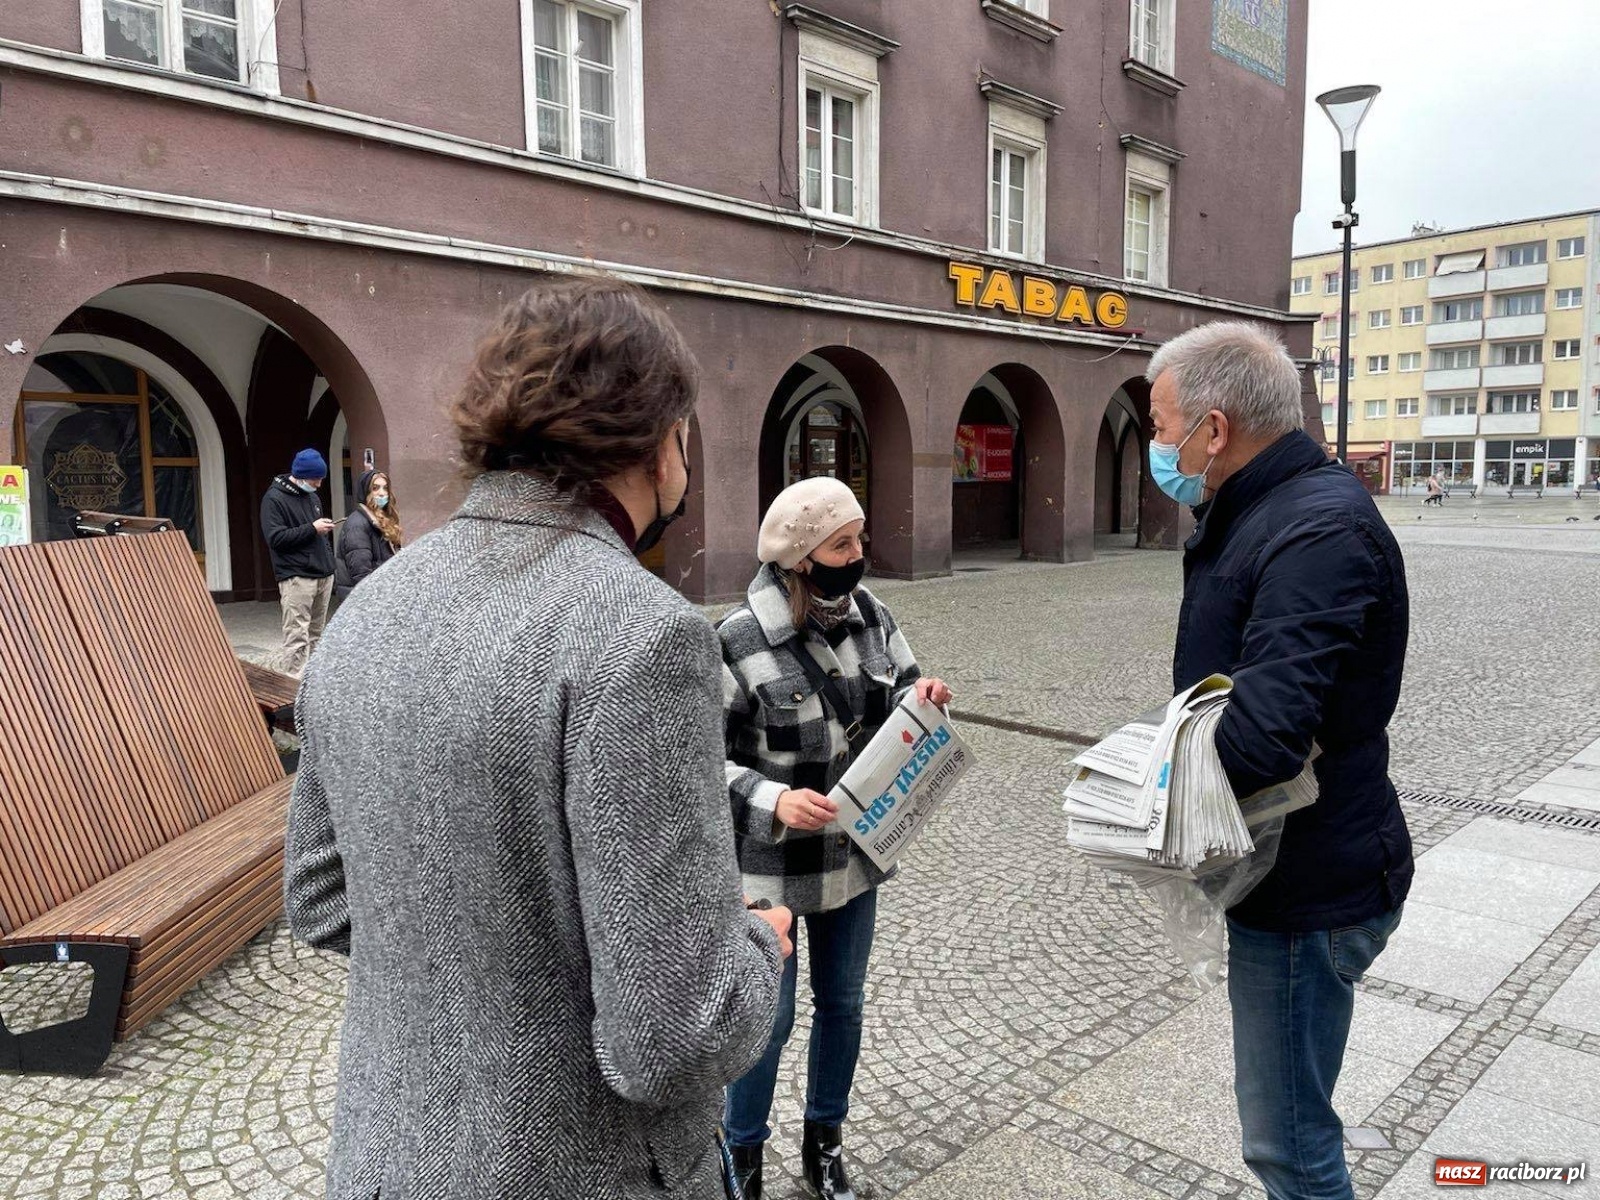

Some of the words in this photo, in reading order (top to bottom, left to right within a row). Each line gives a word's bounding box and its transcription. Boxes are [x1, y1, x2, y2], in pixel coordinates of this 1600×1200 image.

[948, 261, 1128, 329] TABAC
[1515, 443, 1545, 454] empik
[56, 475, 96, 485] CACTUS
[101, 475, 119, 485] INK
[854, 790, 897, 837] spis
